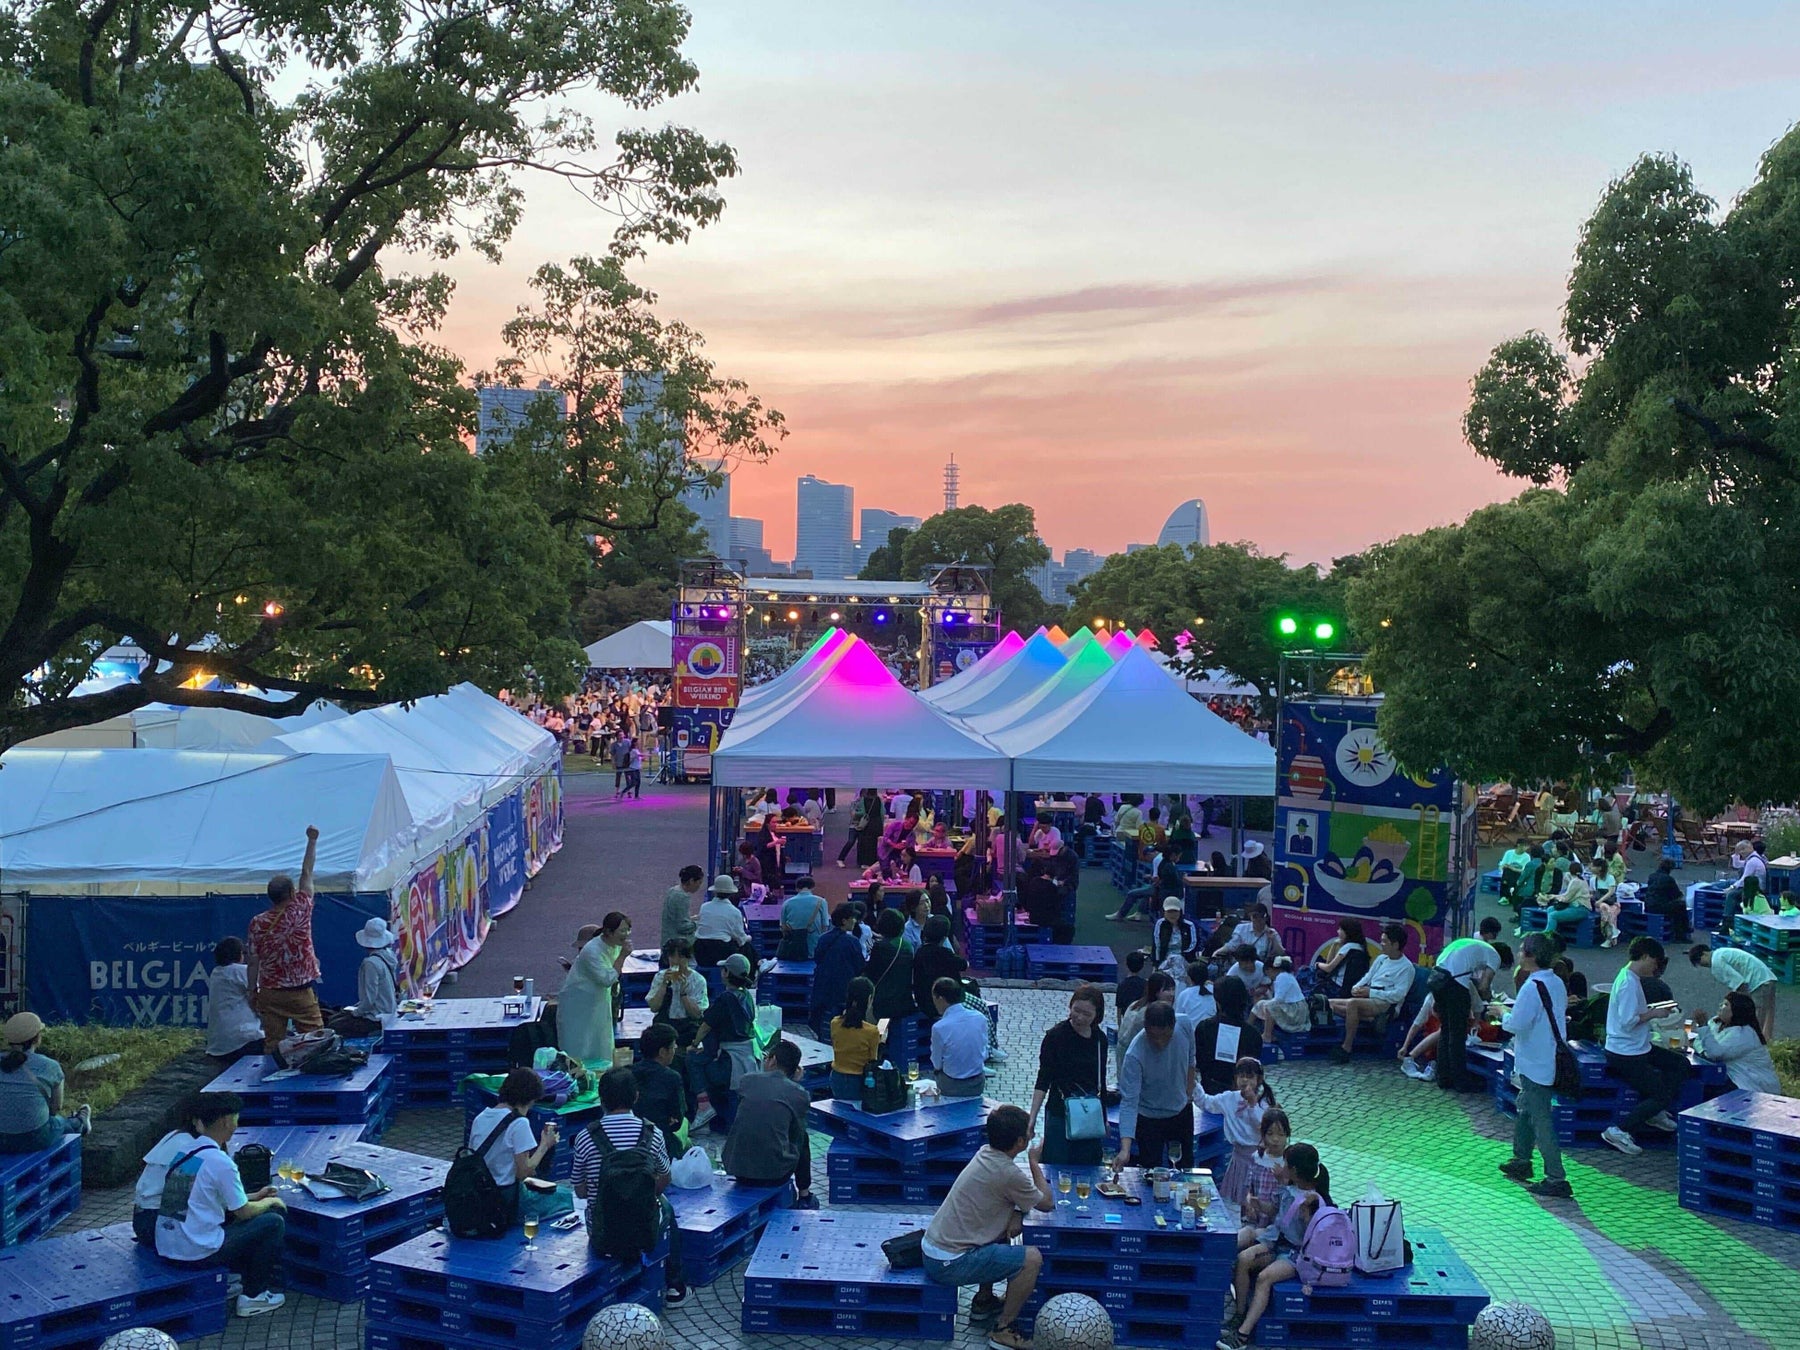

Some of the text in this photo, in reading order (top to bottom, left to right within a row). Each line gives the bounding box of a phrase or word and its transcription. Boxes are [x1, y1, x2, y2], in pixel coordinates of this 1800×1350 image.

[123, 941, 217, 953] ベルギービールウ
[90, 960, 212, 990] BELGIA
